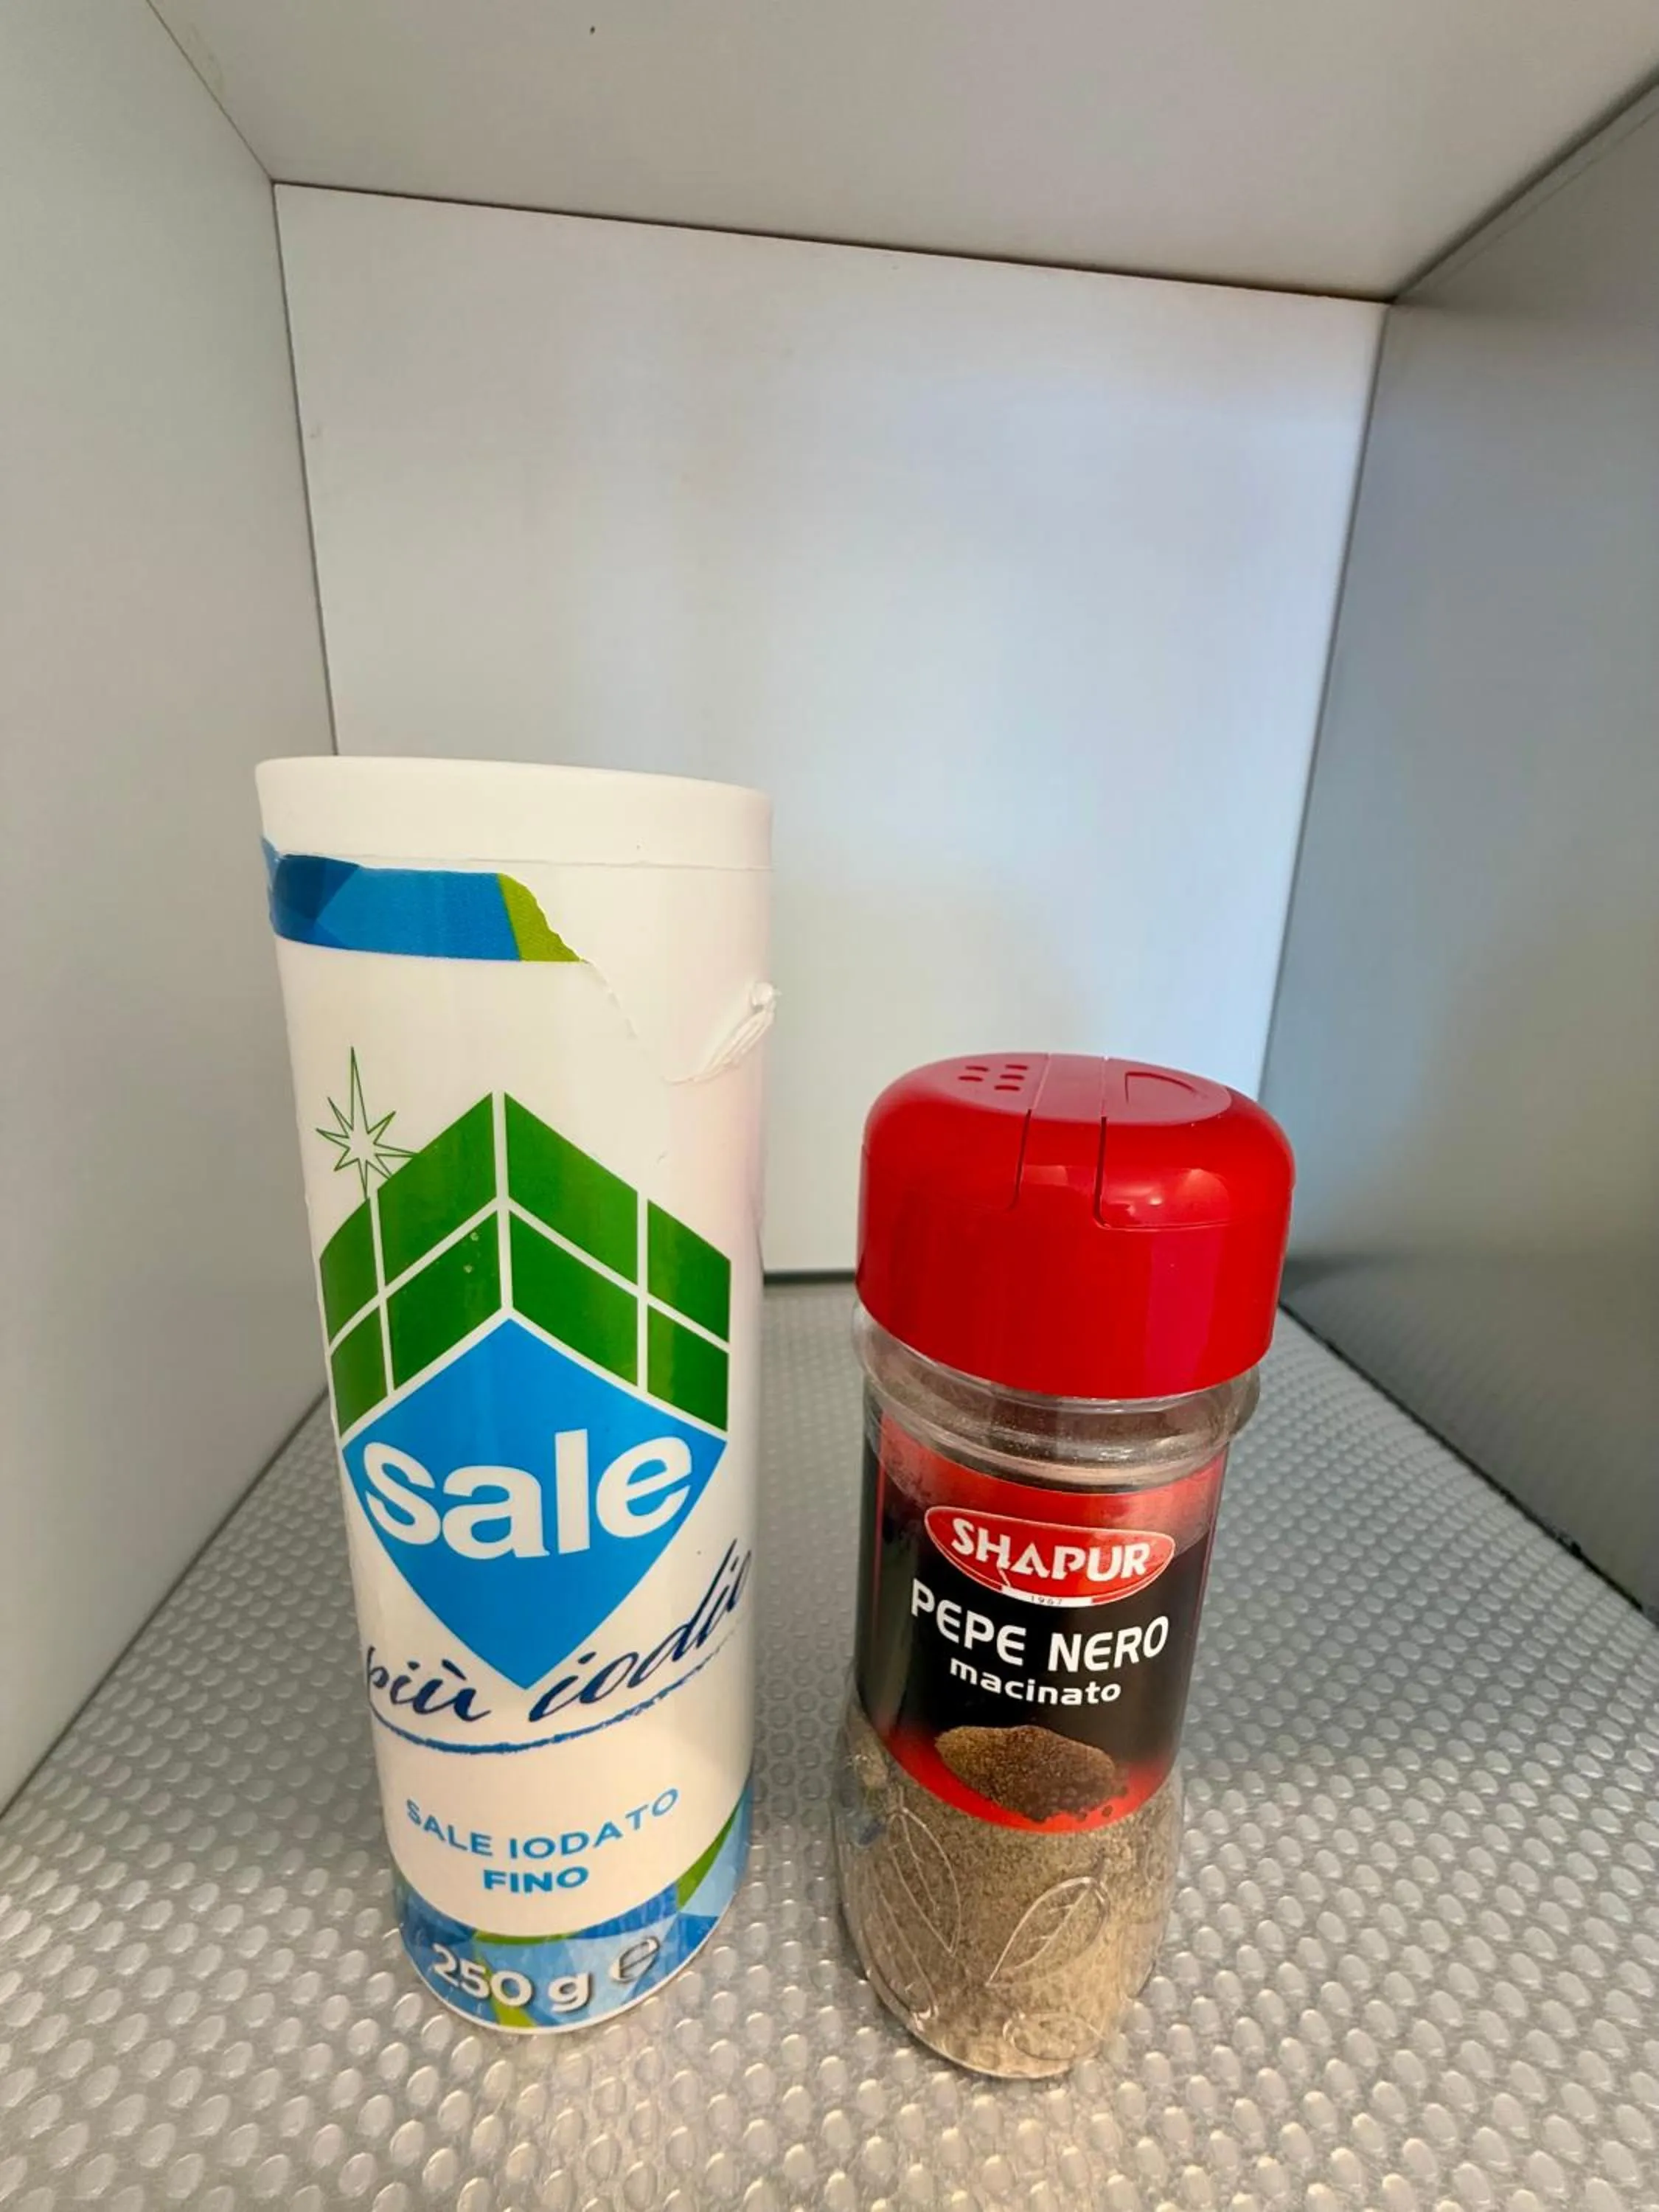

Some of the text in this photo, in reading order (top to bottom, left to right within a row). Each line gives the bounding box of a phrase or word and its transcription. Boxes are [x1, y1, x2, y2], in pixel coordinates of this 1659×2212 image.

[363, 1428, 693, 1559] sale
[951, 1517, 1151, 1582] SHAPUR
[911, 1578, 1169, 1672] PEPE NERO
[950, 1658, 1121, 1705] macinato
[406, 1787, 679, 1860] SALE IODATO
[483, 1867, 589, 1893] FINO
[431, 1942, 532, 2008] 250
[547, 1969, 594, 2014] g
